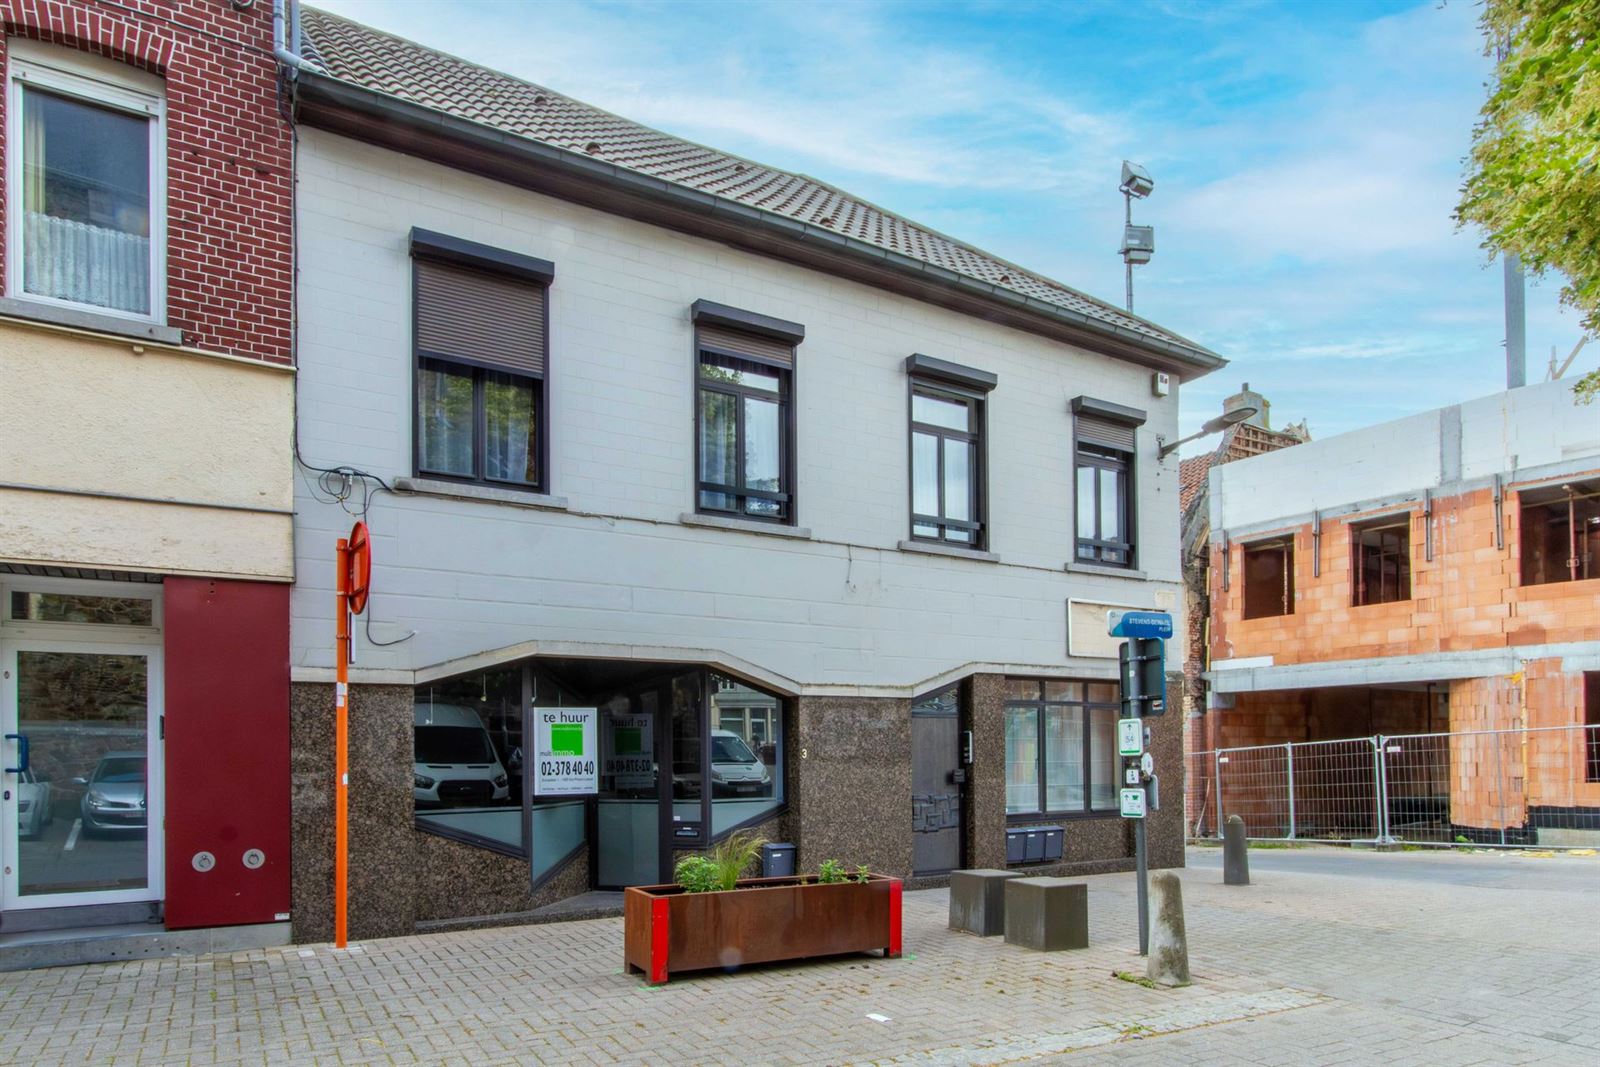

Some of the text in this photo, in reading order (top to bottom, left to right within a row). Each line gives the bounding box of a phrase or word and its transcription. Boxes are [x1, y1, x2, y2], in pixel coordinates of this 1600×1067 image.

[543, 711, 589, 722] te huur
[802, 749, 807, 758] 3
[541, 760, 595, 776] 02-378 40 40
